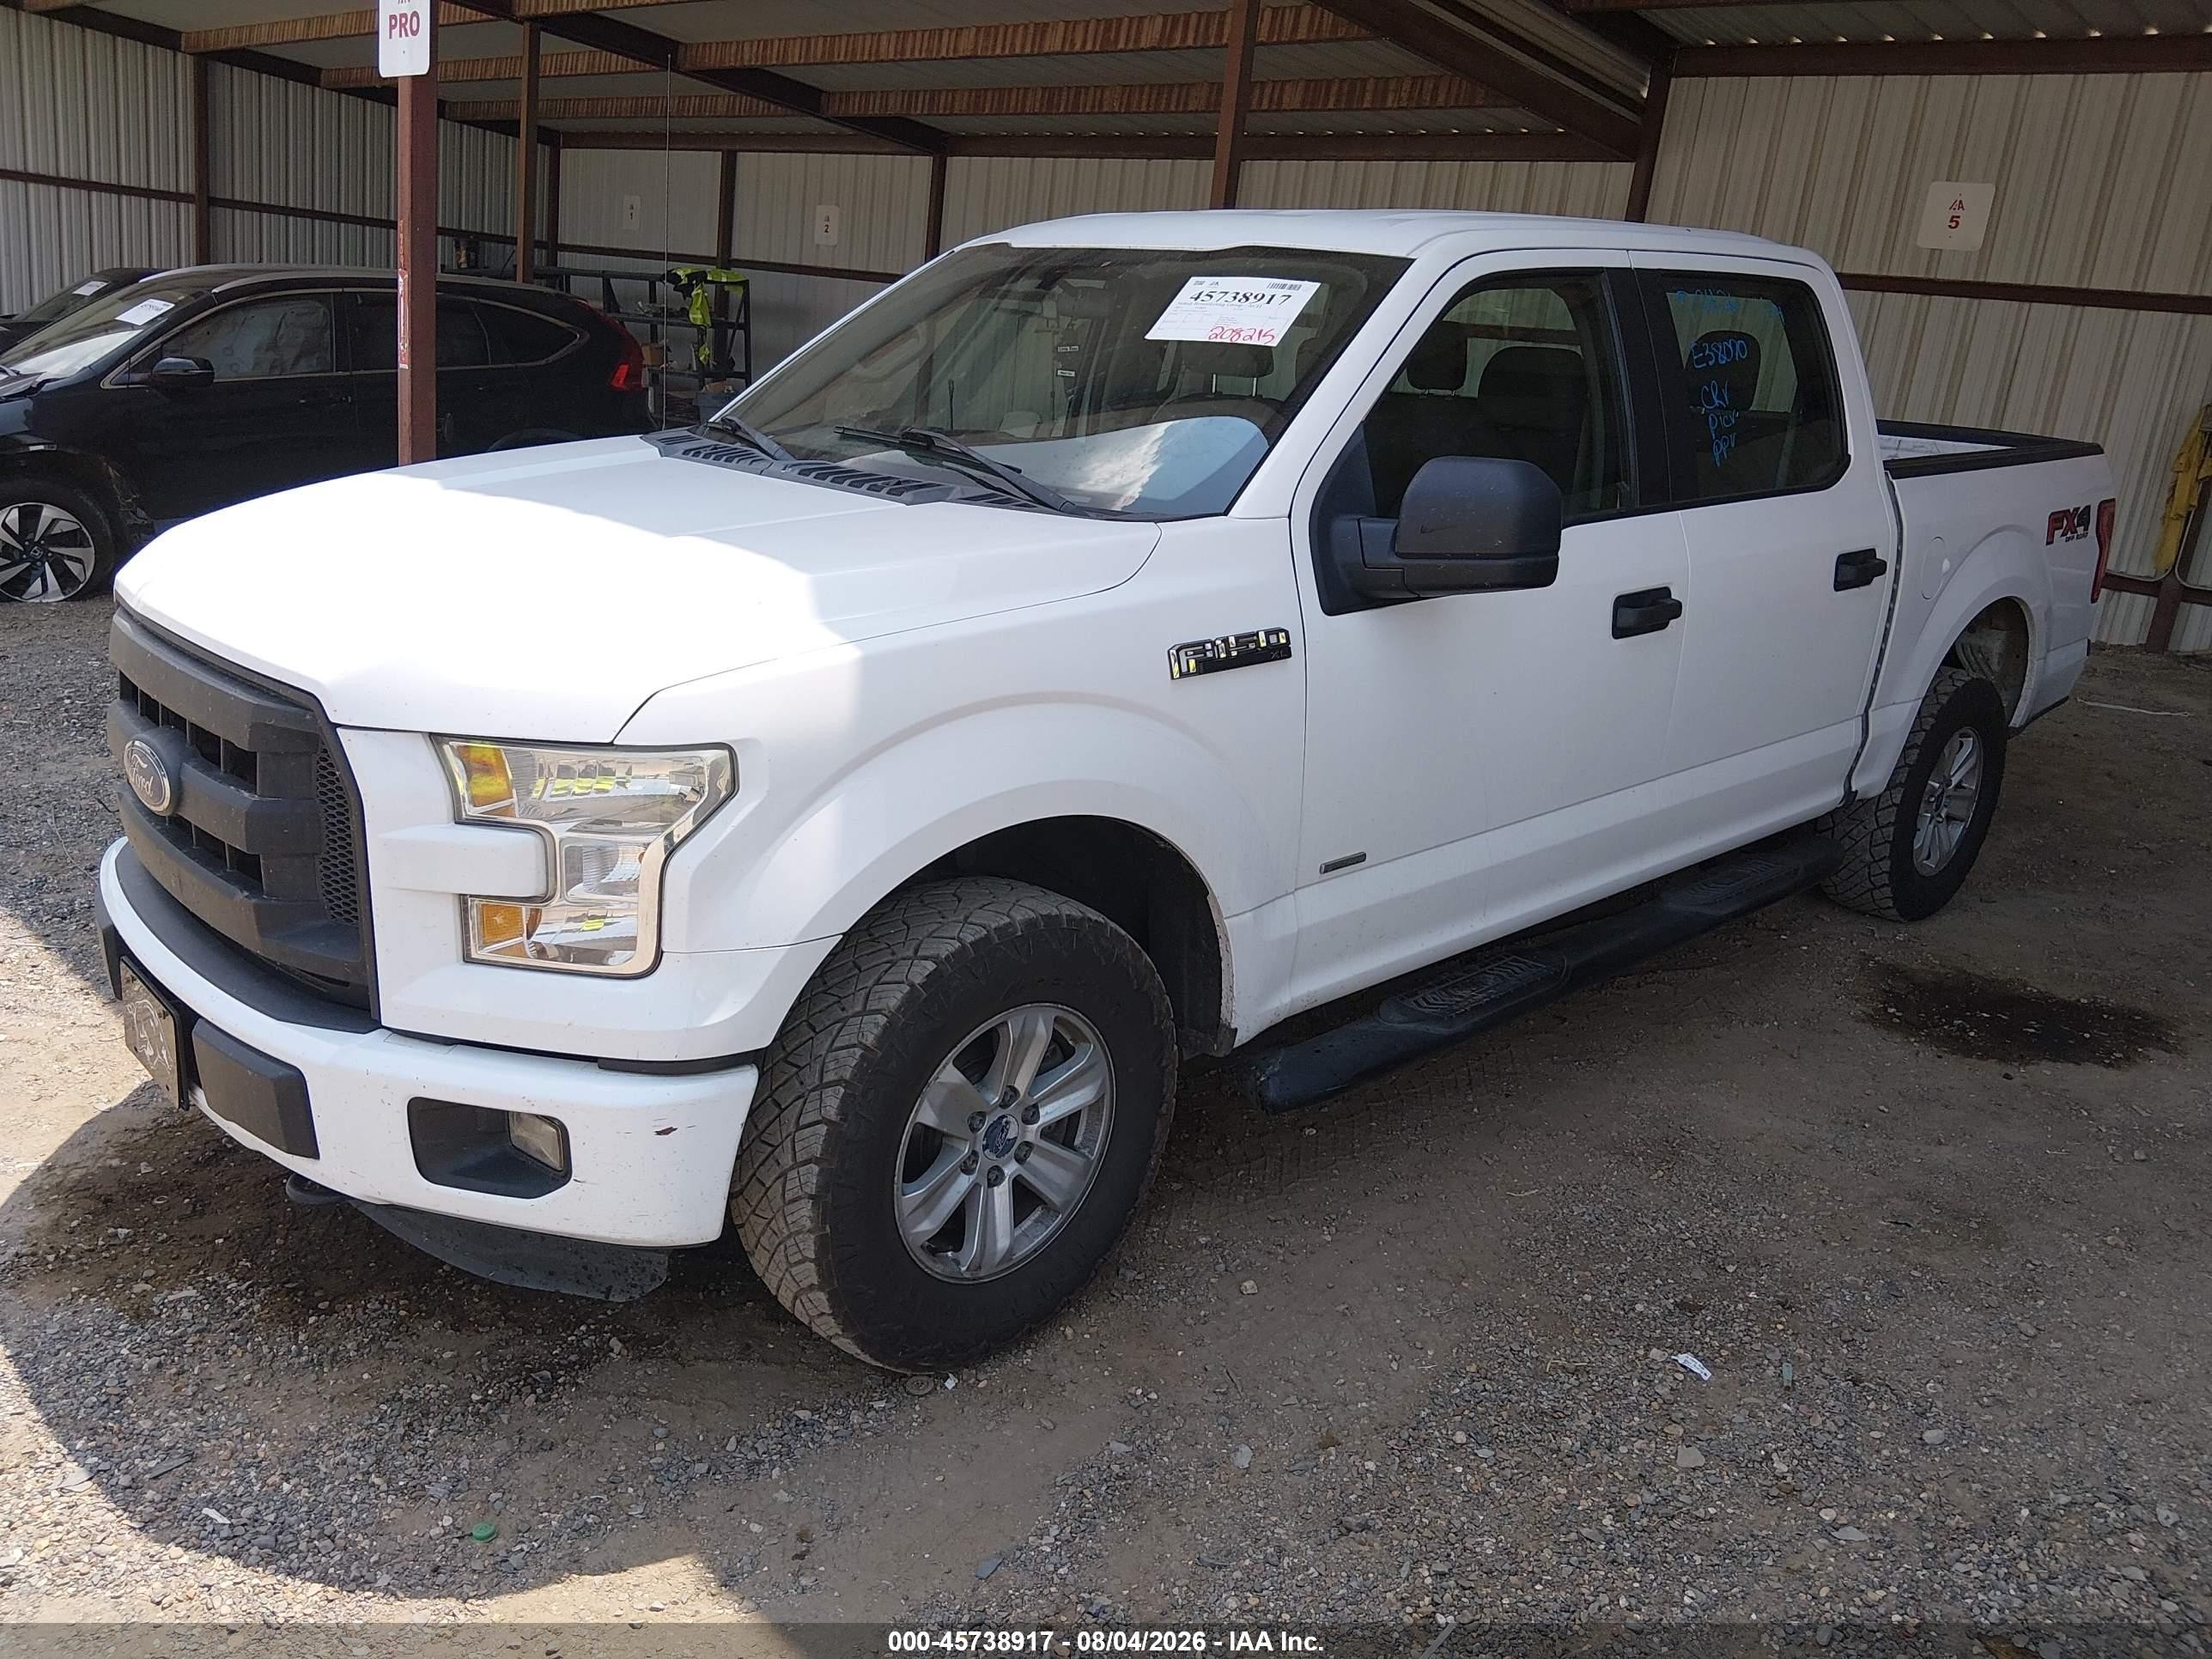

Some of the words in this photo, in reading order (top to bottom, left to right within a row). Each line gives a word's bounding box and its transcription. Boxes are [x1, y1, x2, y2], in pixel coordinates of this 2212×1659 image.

[388, 10, 421, 40] PRO
[823, 223, 830, 234] 2
[1948, 215, 1961, 230] 5
[1189, 289, 1292, 307] 45738917
[2045, 505, 2092, 546] FX4
[129, 753, 155, 799] Ford
